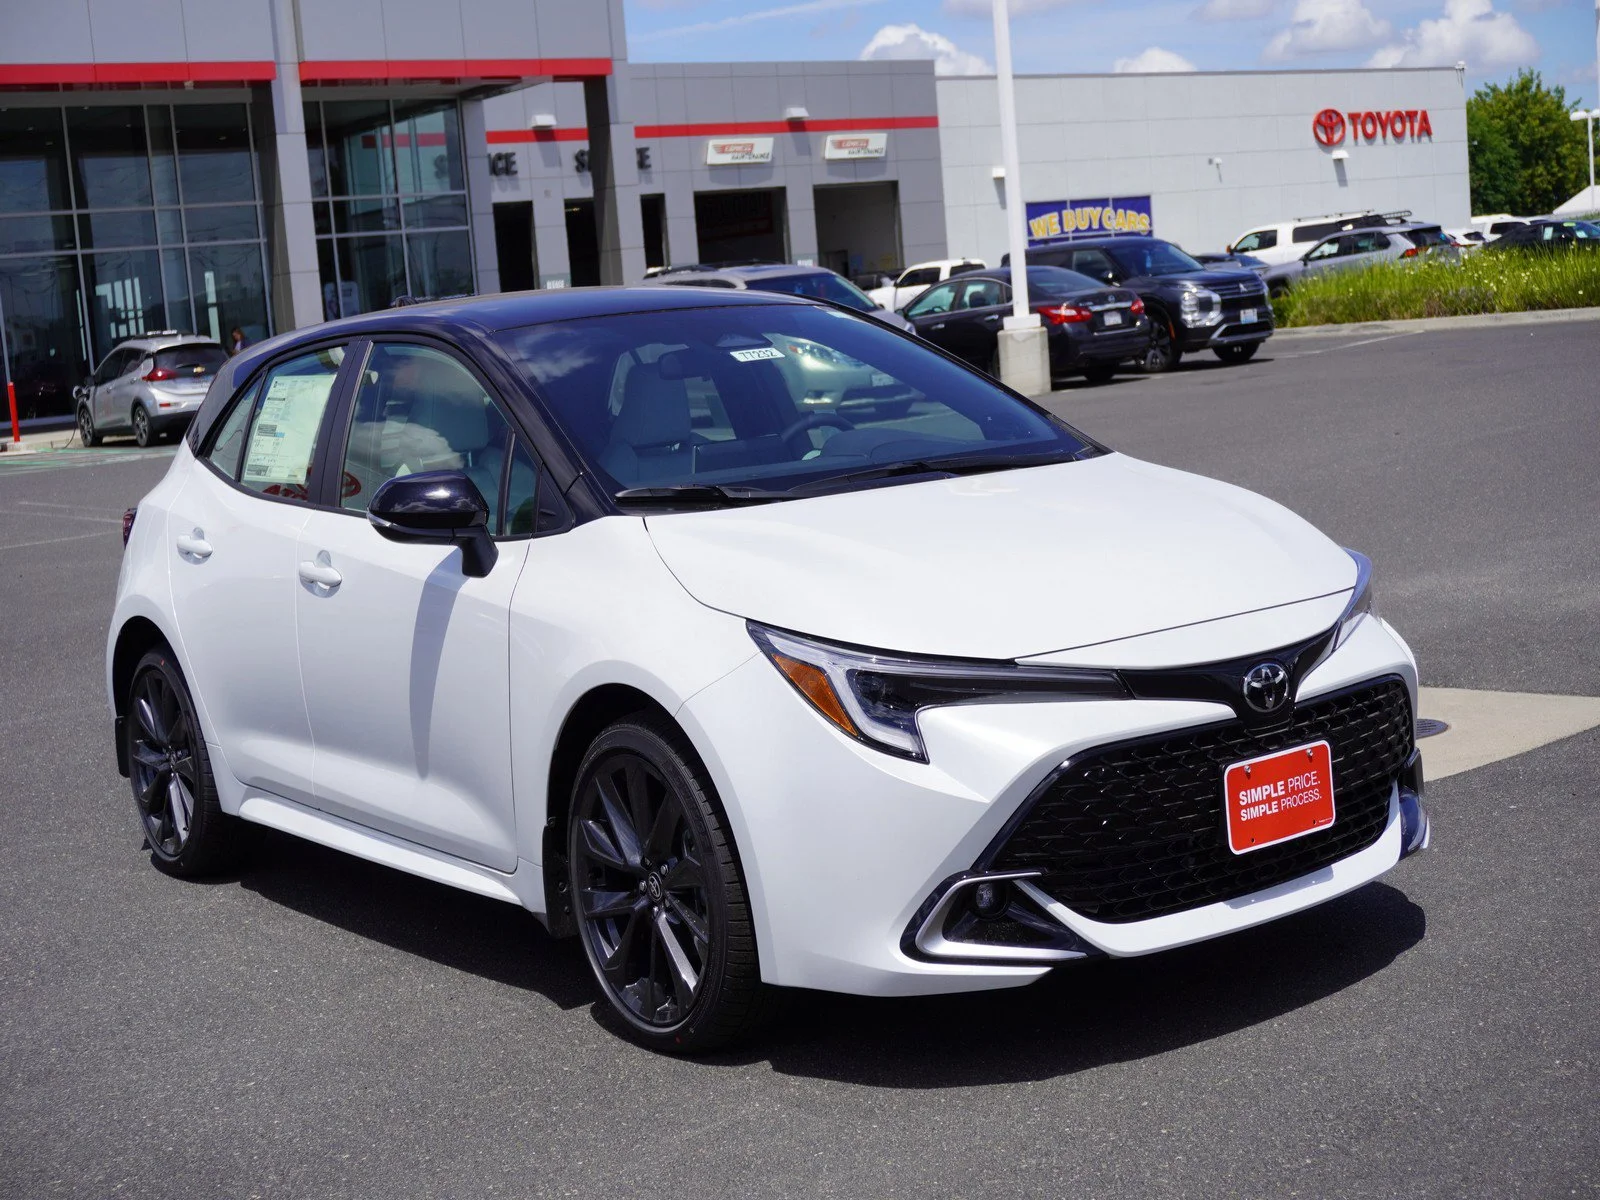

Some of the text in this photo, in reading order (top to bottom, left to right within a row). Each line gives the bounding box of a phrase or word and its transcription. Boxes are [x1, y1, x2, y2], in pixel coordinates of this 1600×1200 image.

[1347, 109, 1433, 141] TOYOTA
[1029, 207, 1150, 240] WE BUY CARS
[1239, 770, 1321, 806] SIMPLE PRICE.
[1240, 788, 1322, 821] SIMPLE PROCESS.
